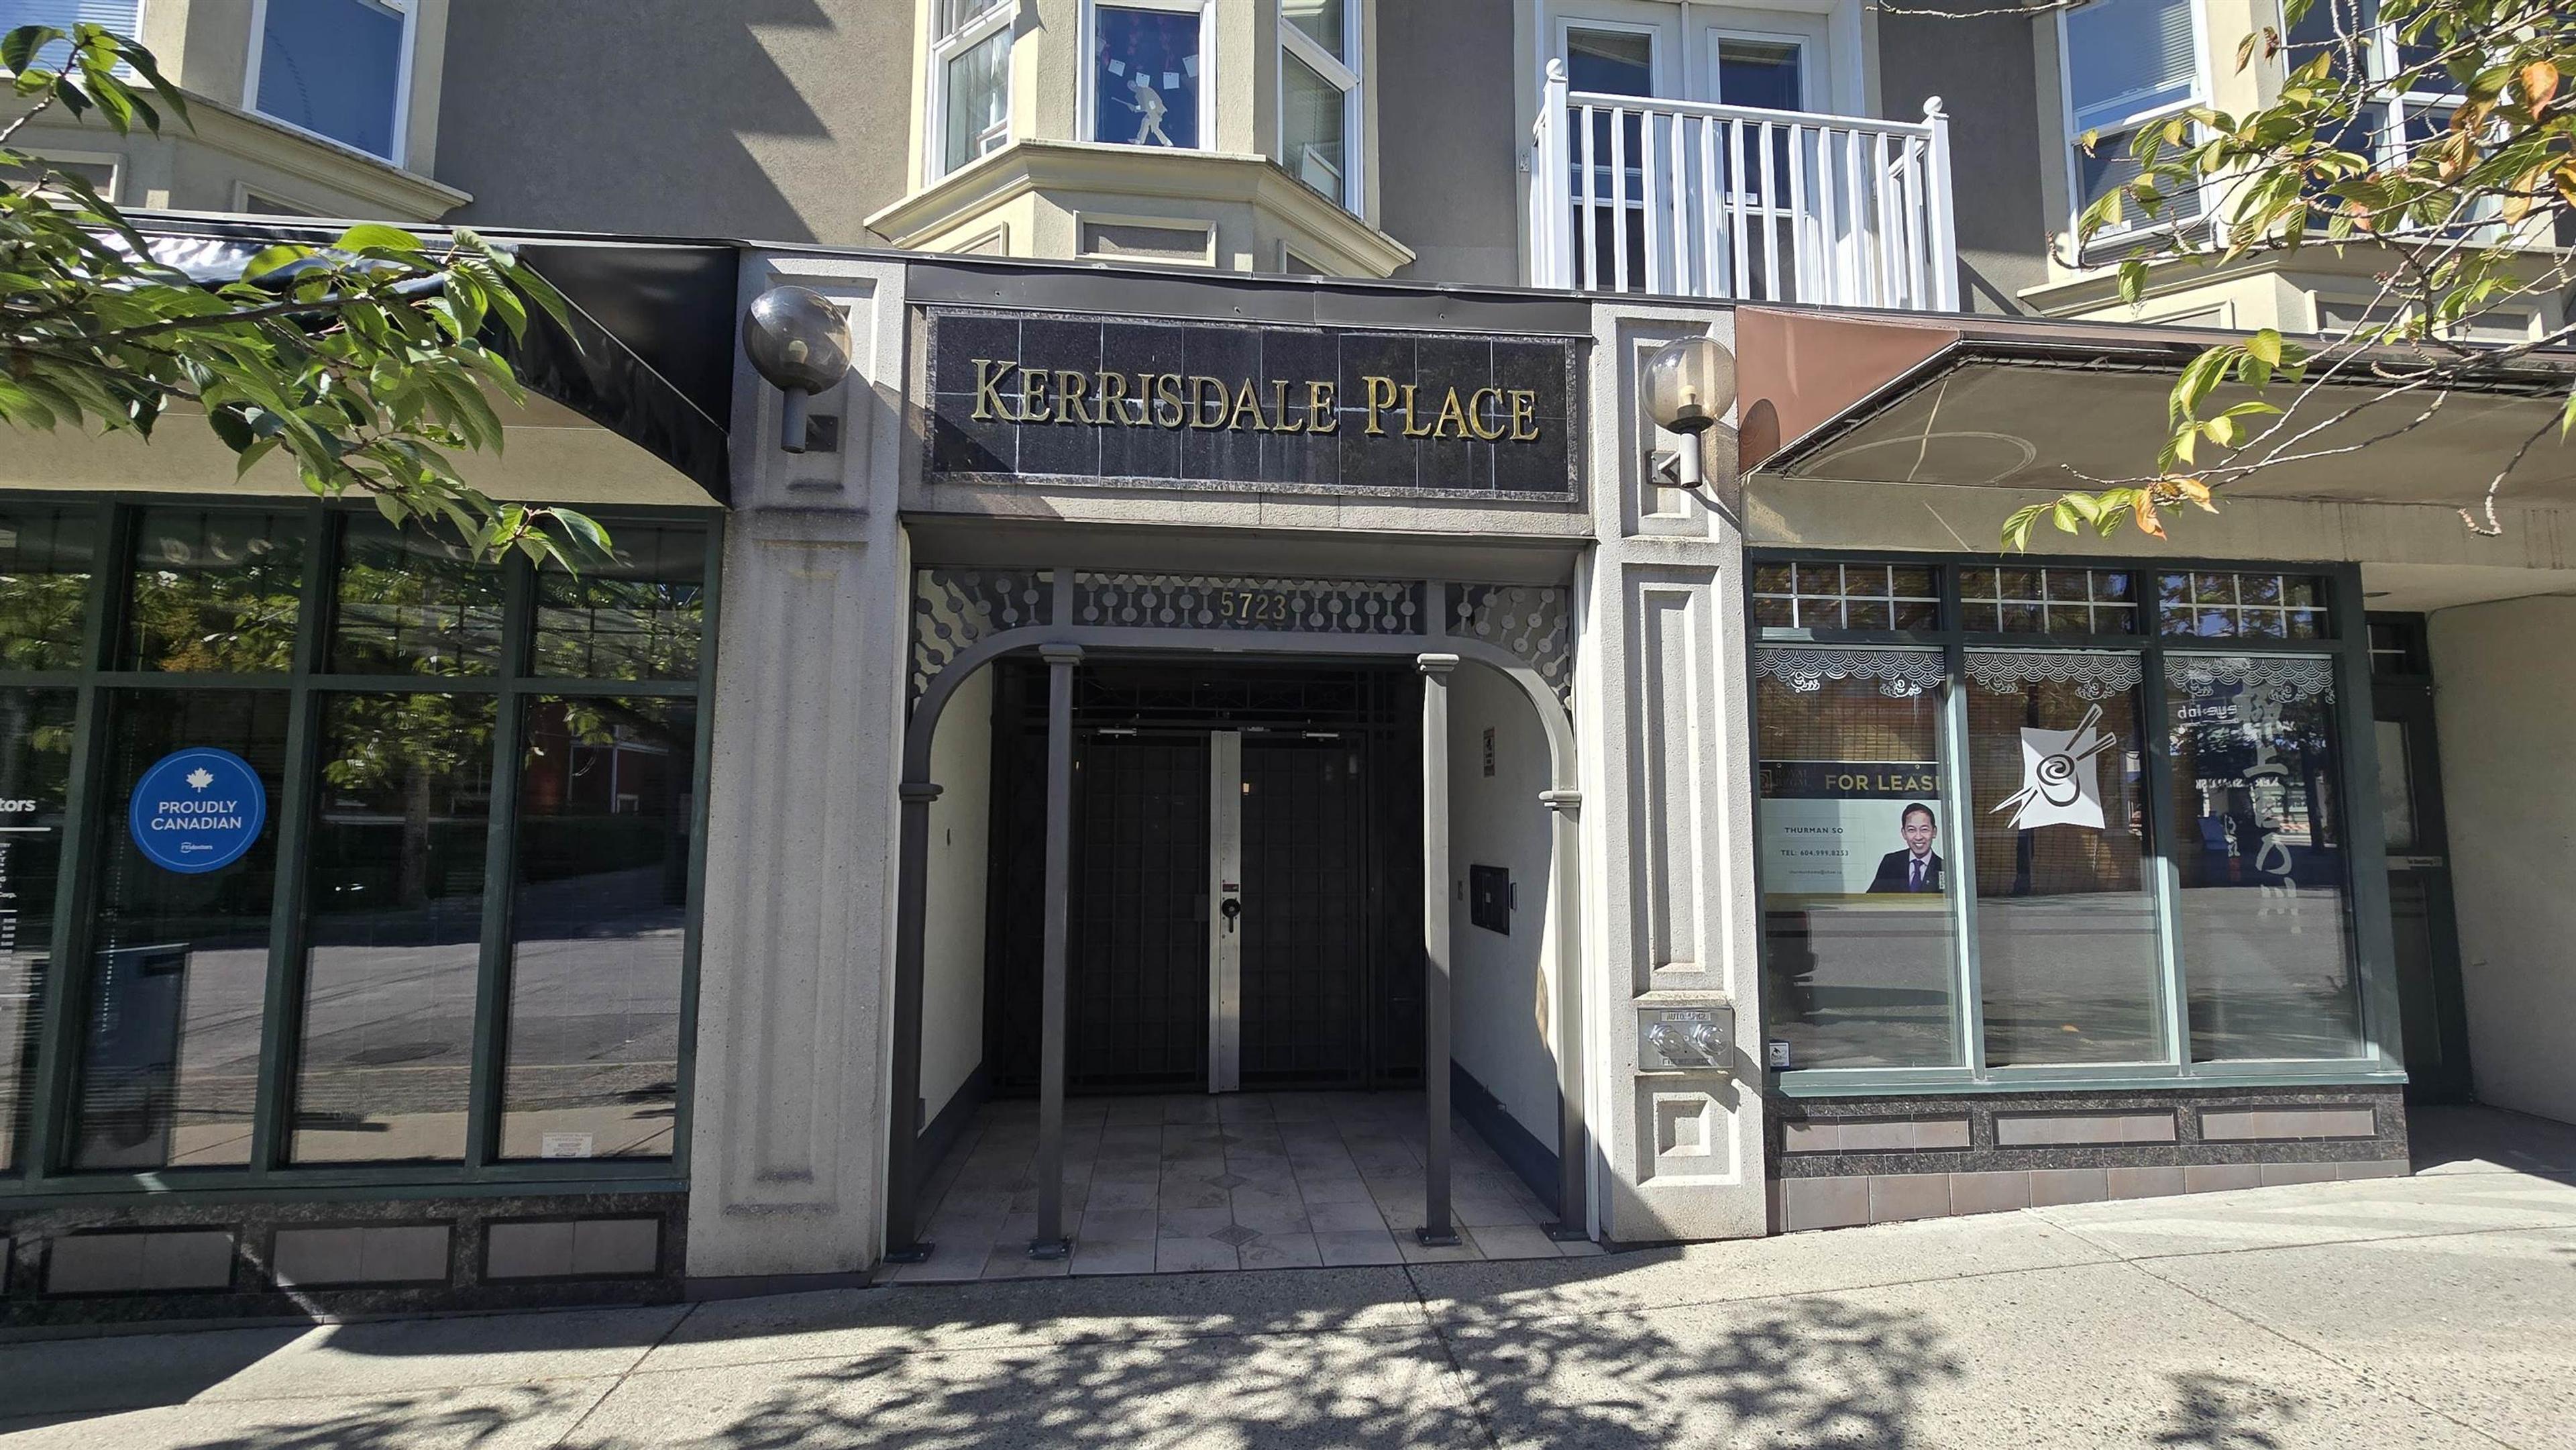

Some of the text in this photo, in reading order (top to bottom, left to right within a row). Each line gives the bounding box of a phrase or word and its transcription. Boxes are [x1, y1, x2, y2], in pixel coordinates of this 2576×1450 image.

[971, 358, 1539, 440] KERRISDALE PLACE
[1221, 592, 1286, 620] 5723
[1825, 774, 1869, 790] FOR
[158, 800, 237, 814] PROUDLY
[151, 817, 242, 831] CANADIAN
